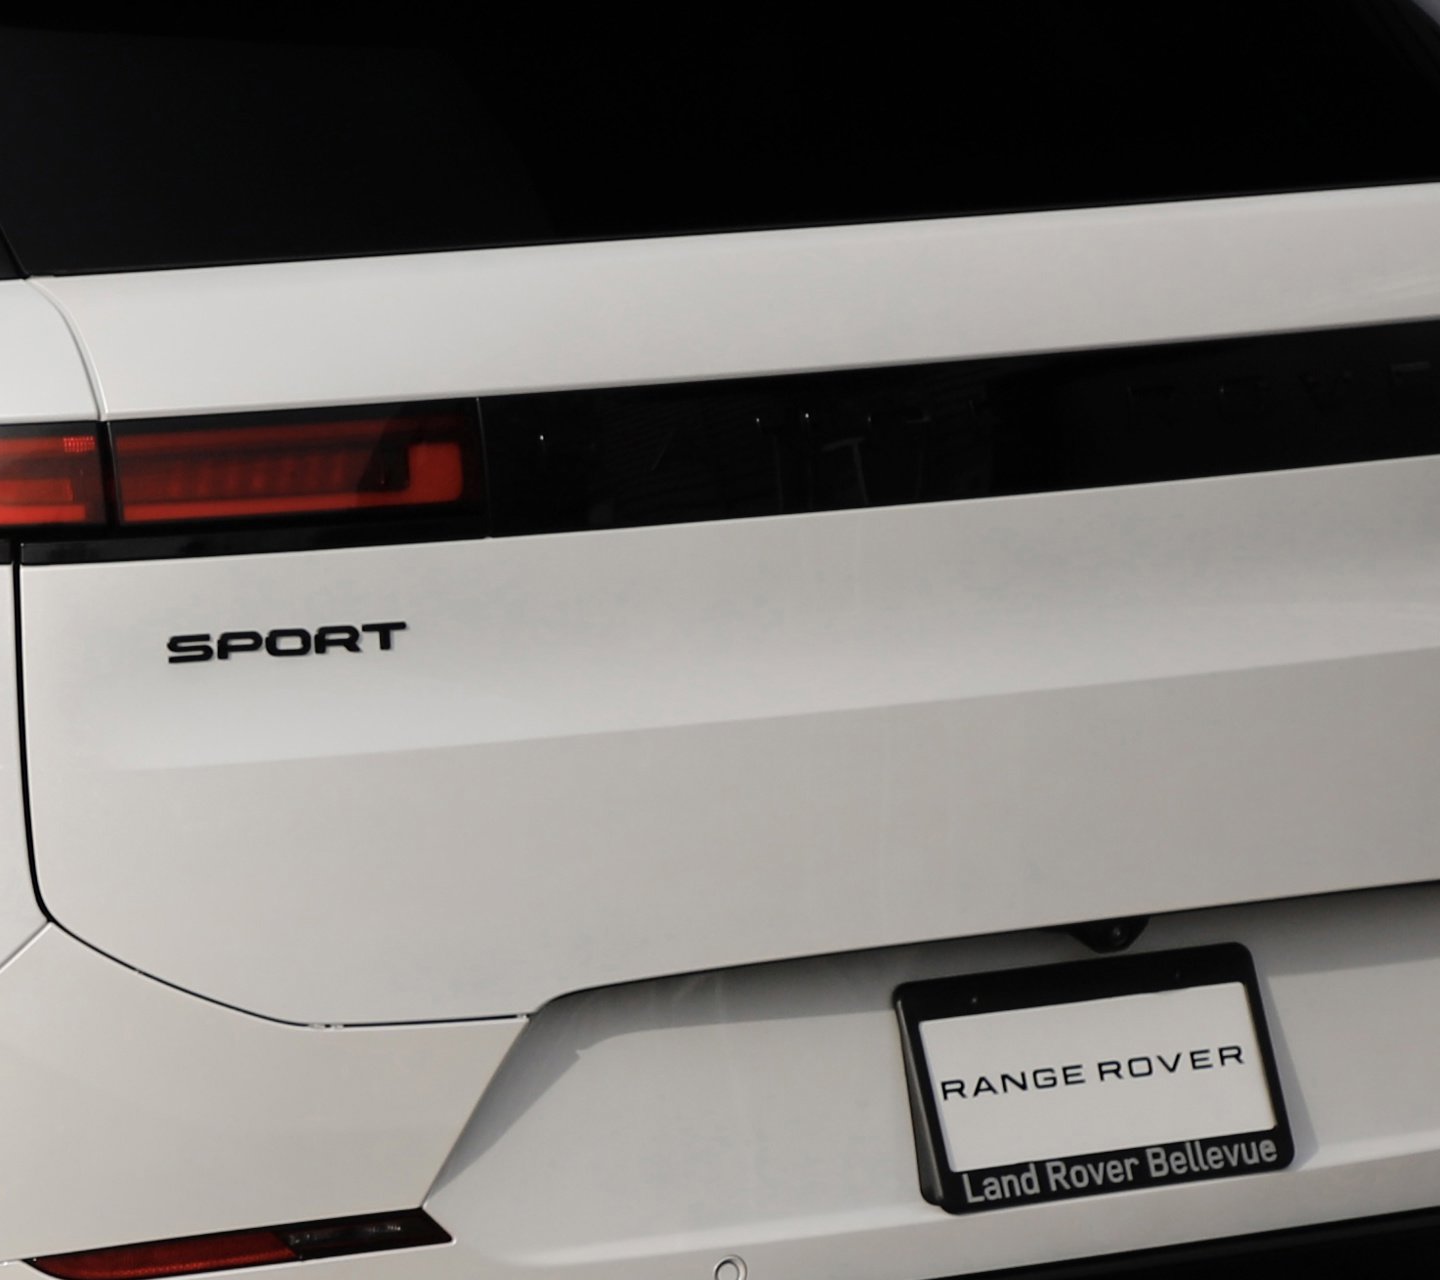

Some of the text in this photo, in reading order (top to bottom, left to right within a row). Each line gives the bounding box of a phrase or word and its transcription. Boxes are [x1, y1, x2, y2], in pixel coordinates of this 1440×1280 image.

[166, 621, 408, 664] SPORT
[940, 1045, 1244, 1101] RANGE ROVER
[962, 1139, 1278, 1204] Land Rover Bellevue
